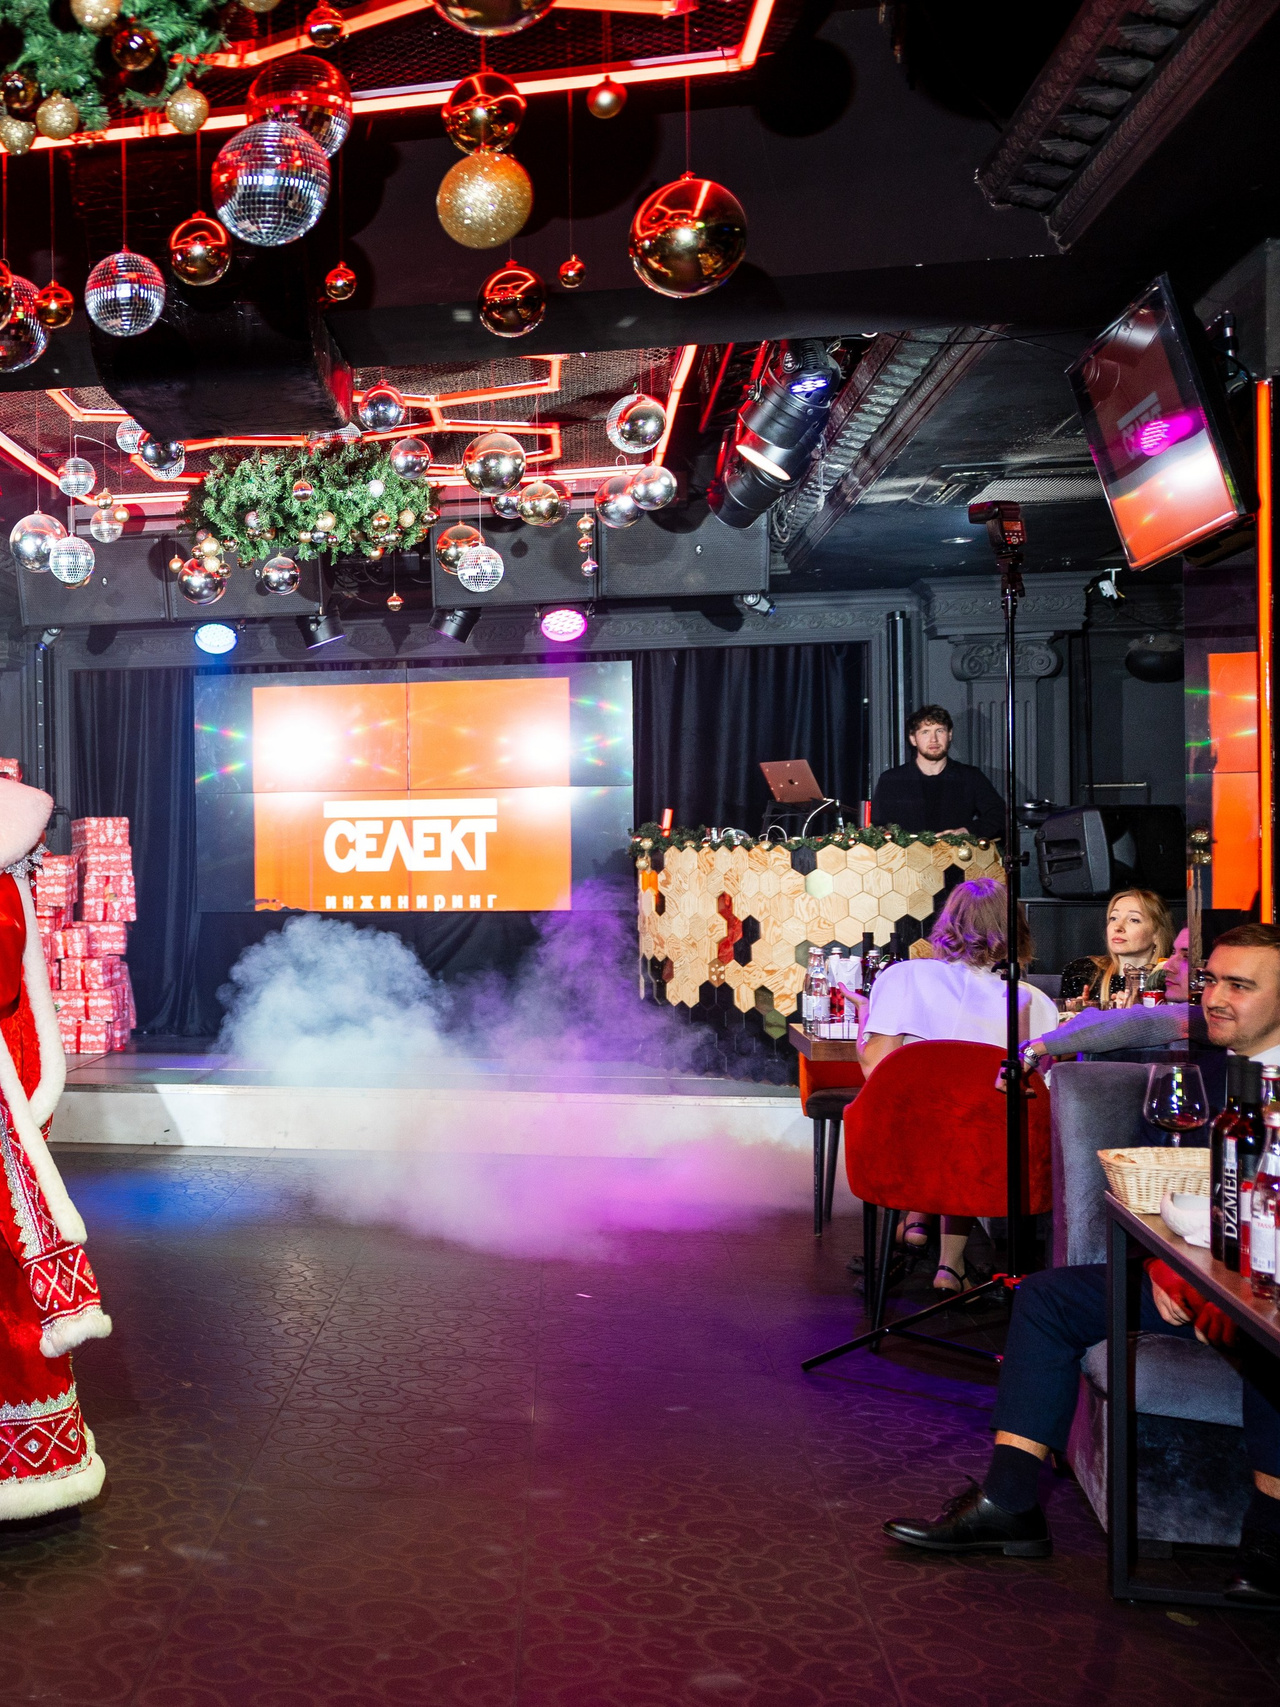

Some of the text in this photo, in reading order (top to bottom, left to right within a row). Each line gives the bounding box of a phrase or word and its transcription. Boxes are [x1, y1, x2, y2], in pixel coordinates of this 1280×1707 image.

[323, 818, 498, 874] СЕЛЕКТ
[324, 894, 498, 912] инжиниринг
[1224, 1168, 1238, 1240] DZMEB
